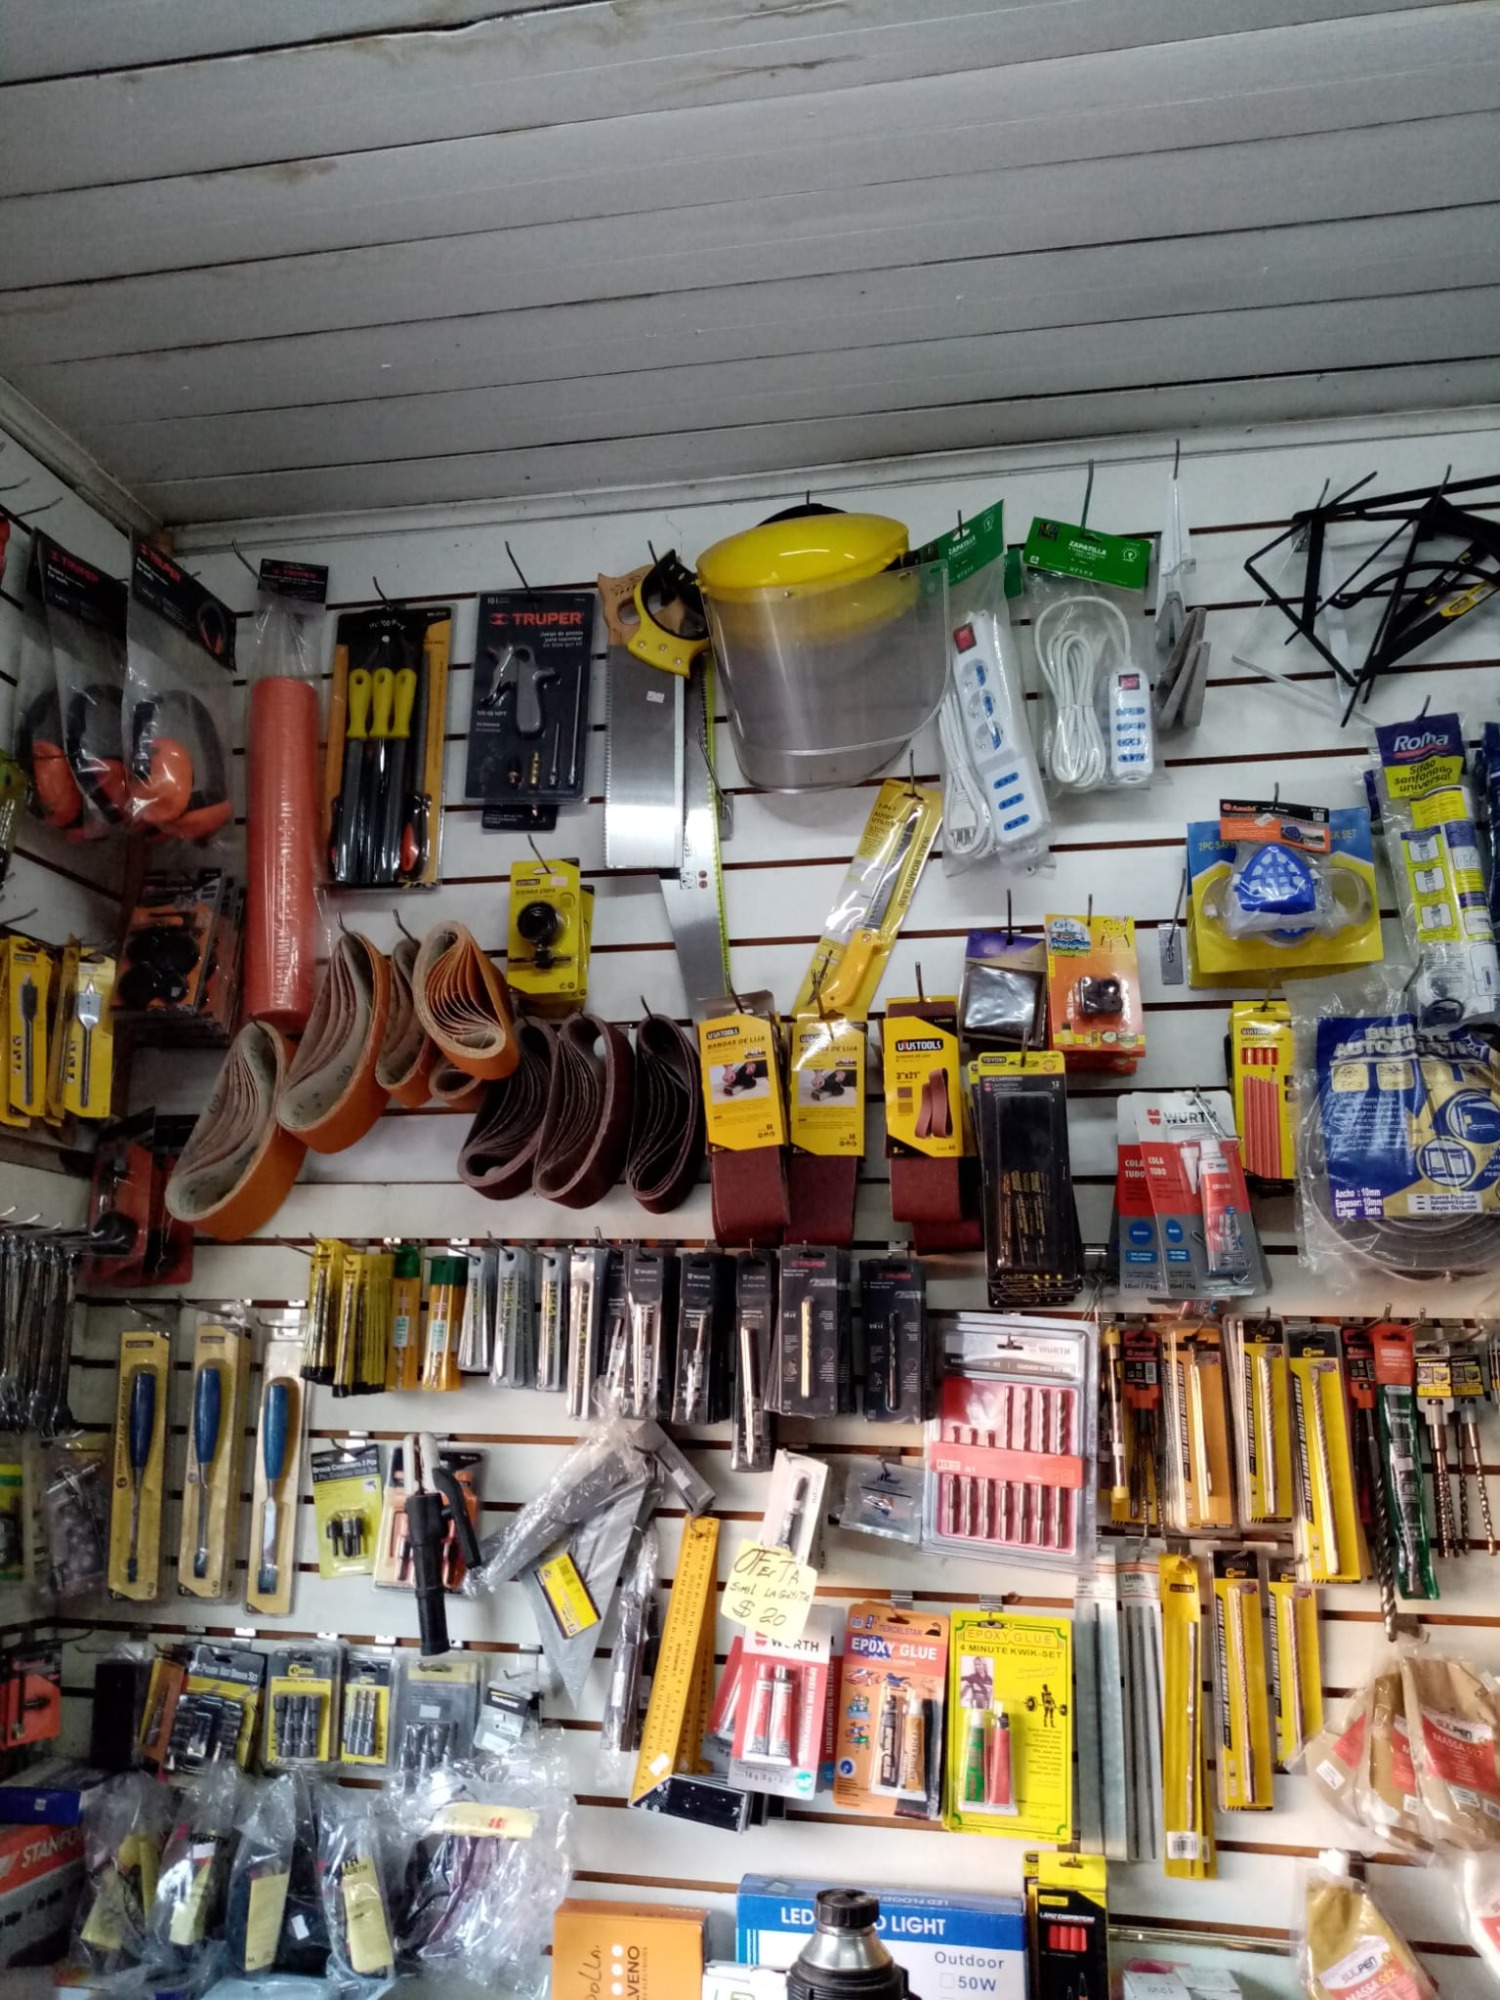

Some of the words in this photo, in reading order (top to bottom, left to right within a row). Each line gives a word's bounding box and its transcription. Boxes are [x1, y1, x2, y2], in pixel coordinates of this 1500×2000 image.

[1068, 539, 1108, 556] ZAPATILLA
[511, 611, 583, 626] TRUPER
[1393, 731, 1449, 752] Roma
[1409, 758, 1436, 775] Sifão
[1399, 771, 1451, 793] universal
[905, 859, 923, 888] BOARD
[749, 1036, 765, 1044] LIJA
[1125, 1159, 1145, 1168] COLA
[1148, 1156, 1165, 1165] COLA
[1125, 1170, 1145, 1178] TUDO
[1149, 1167, 1167, 1176] TUDO
[1335, 1188, 1355, 1198] Ancho
[1361, 1188, 1381, 1197] 10mm
[1335, 1199, 1363, 1210] Espesor:
[1363, 1198, 1383, 1206] 10mm
[1364, 1207, 1381, 1216] 5mts
[759, 1607, 787, 1626] 20
[968, 1629, 1009, 1642] EPOXY
[1013, 1632, 1052, 1645] GLUE
[851, 1636, 895, 1655] EPOXY
[899, 1643, 938, 1661] GLUE
[968, 1645, 1008, 1655] MINUTE
[1009, 1648, 1063, 1659] KWIK-SET
[1432, 1731, 1465, 1752] MASSA
[780, 1907, 816, 1925] LED
[891, 1915, 946, 1936] LIGHT
[934, 1951, 1005, 1970] Outdoor
[957, 1976, 998, 1992] 50W
[1345, 1980, 1381, 2000] MASSA
